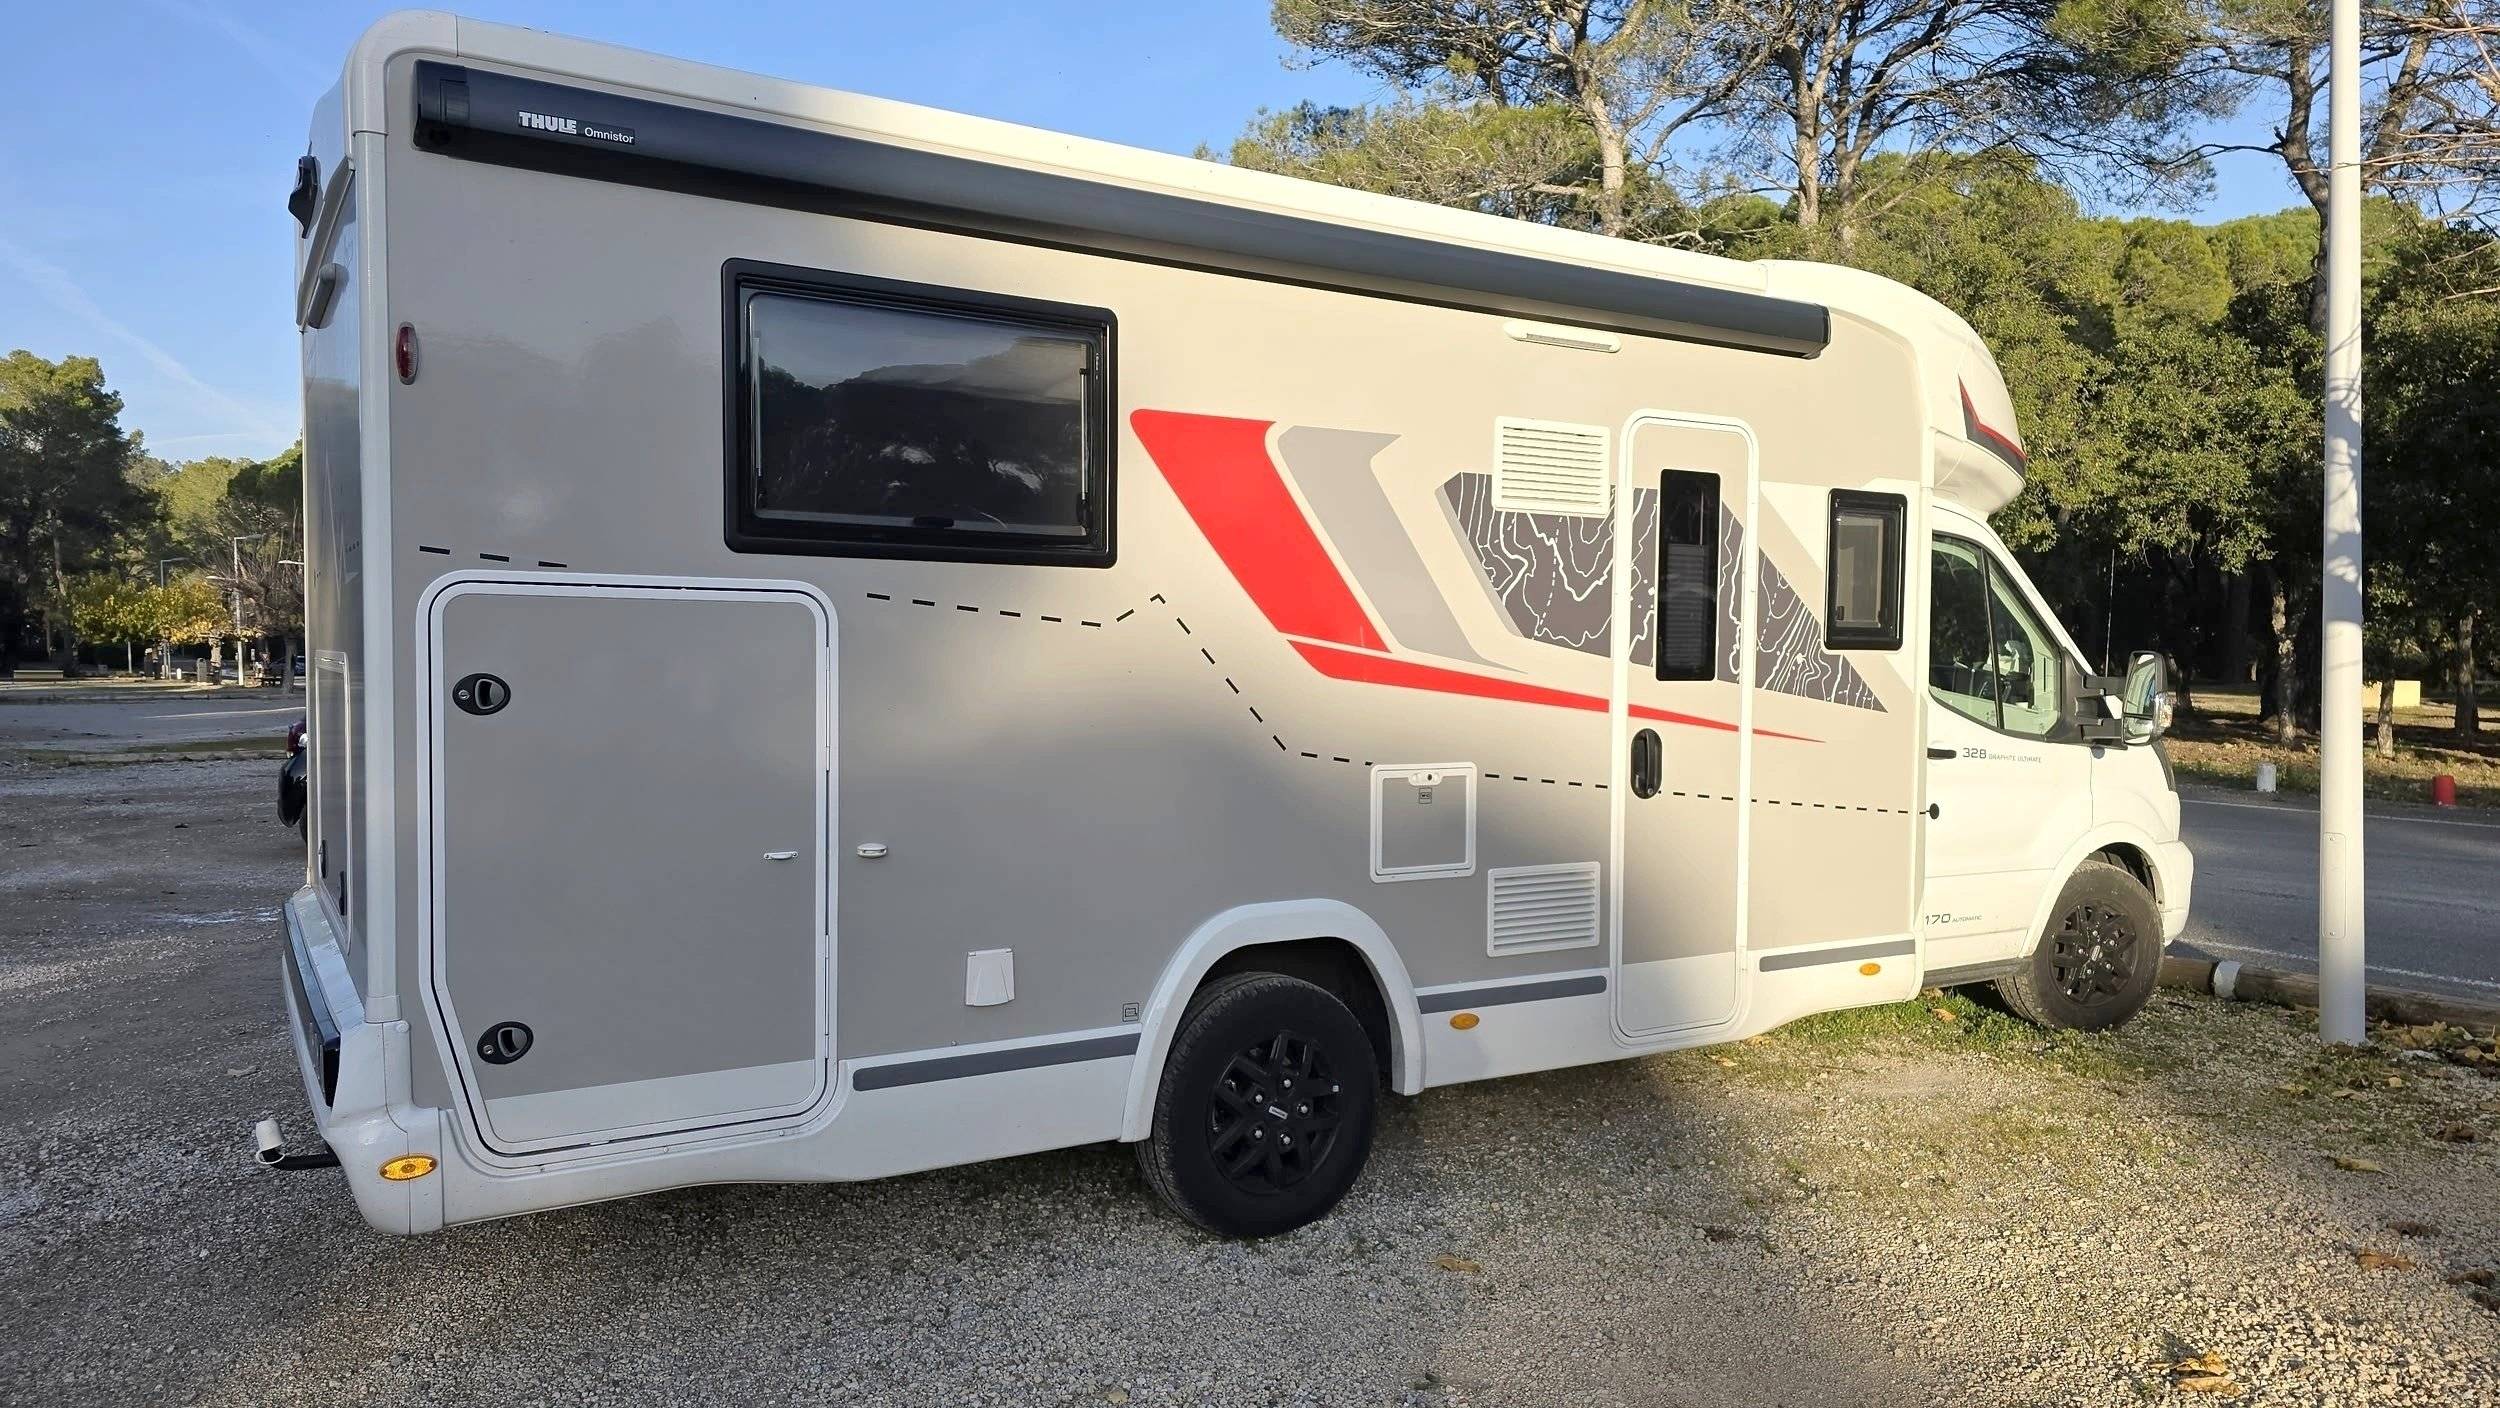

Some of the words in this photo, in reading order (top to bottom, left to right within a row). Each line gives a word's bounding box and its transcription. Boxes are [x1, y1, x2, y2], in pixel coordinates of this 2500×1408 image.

[518, 111, 577, 135] THULE
[584, 127, 634, 144] Omnistor
[1962, 747, 1987, 759] 328
[1925, 913, 1951, 925] 170
